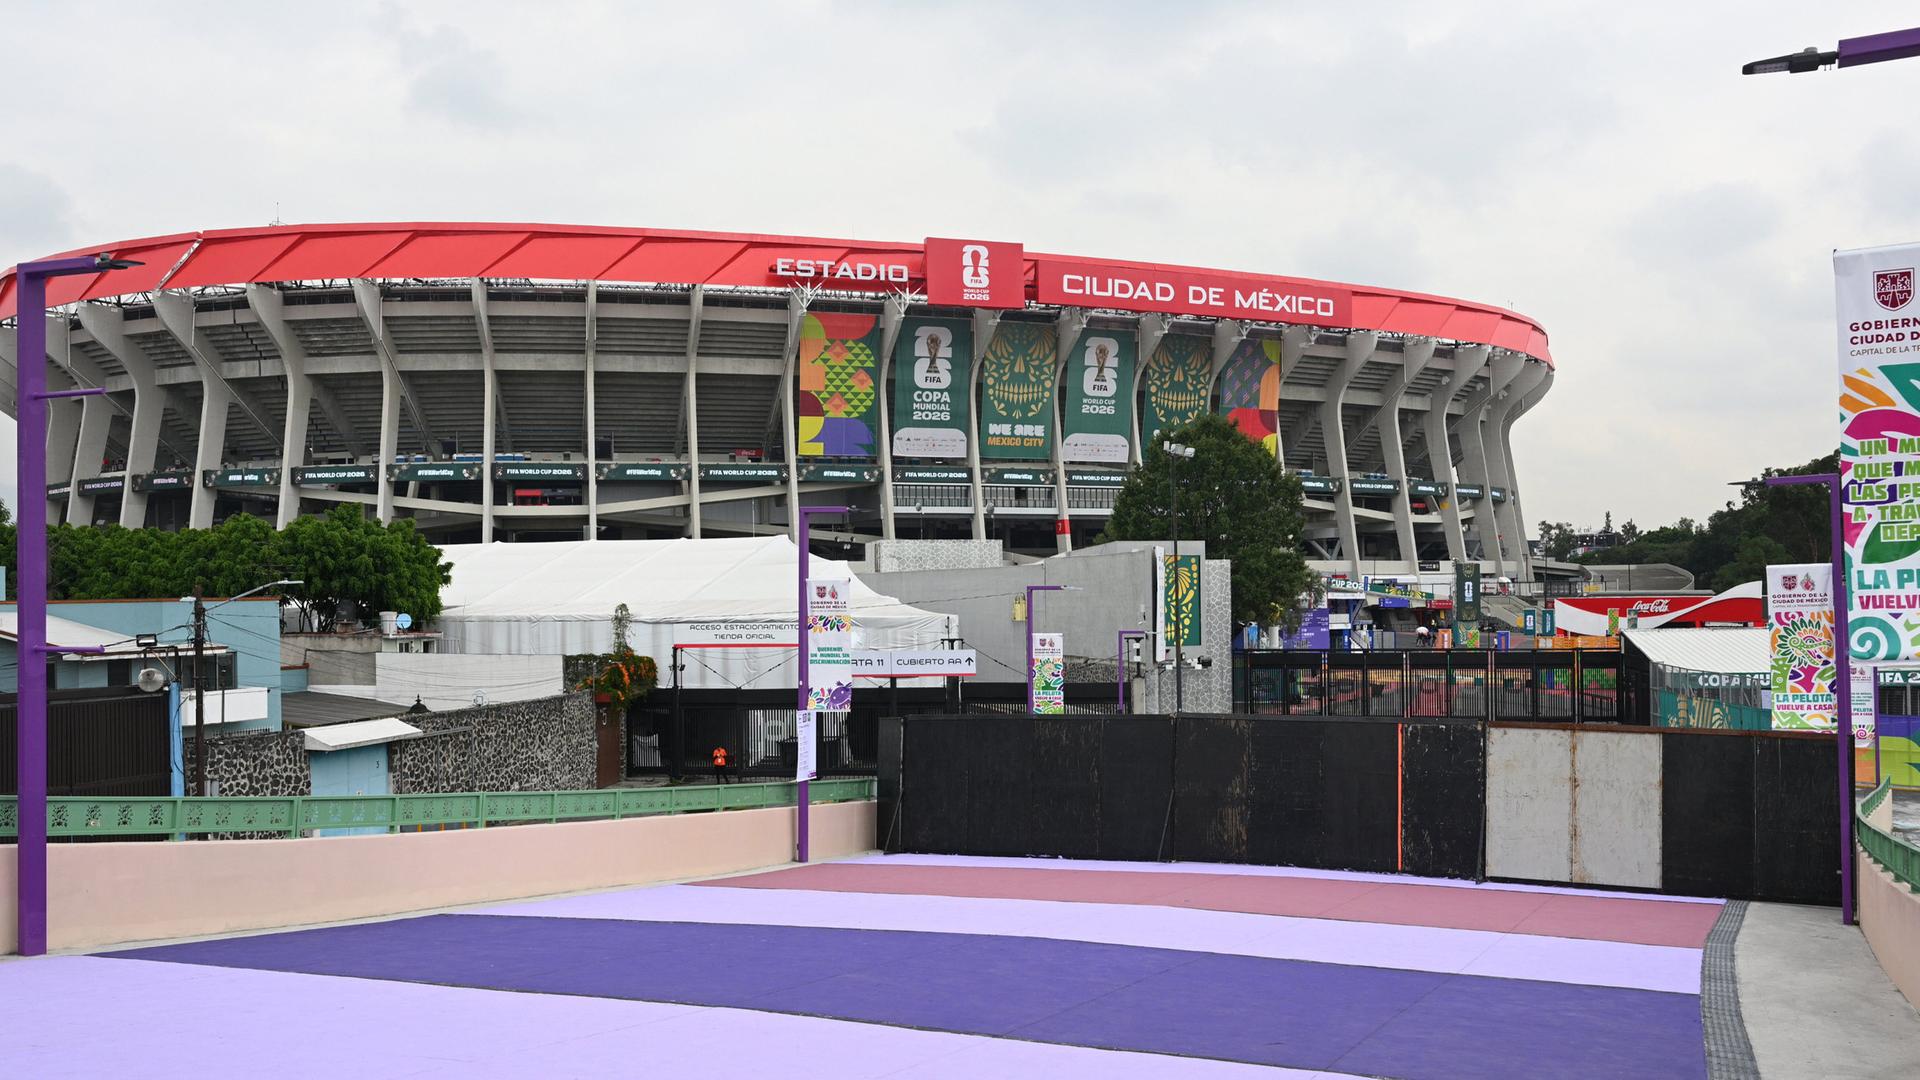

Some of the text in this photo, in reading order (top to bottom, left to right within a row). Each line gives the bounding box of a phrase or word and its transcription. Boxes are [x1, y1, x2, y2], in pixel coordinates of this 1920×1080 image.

[776, 258, 909, 282] ESTADIO
[1062, 274, 1334, 316] CIUDAD DE MÉXICO
[1850, 332, 1905, 345] CIUDAD
[1850, 347, 1884, 356] CAPITAL
[913, 390, 951, 402] COPA
[912, 402, 951, 410] MUNDIAL
[1082, 404, 1116, 414] 2026
[912, 411, 951, 420] 2026
[988, 423, 1012, 436] WE
[988, 436, 1044, 446] MEXICO CITY
[1860, 437, 1920, 456] UN M
[1854, 462, 1893, 480] QUE
[1850, 484, 1888, 500] LAS
[1854, 506, 1867, 522] A
[1882, 524, 1920, 540] DEP
[1332, 580, 1346, 588] CUP
[1857, 568, 1920, 590] LA P
[1858, 595, 1920, 610] VUELV
[1698, 674, 1740, 686] COPA
[1776, 694, 1832, 702] LA PELOTA
